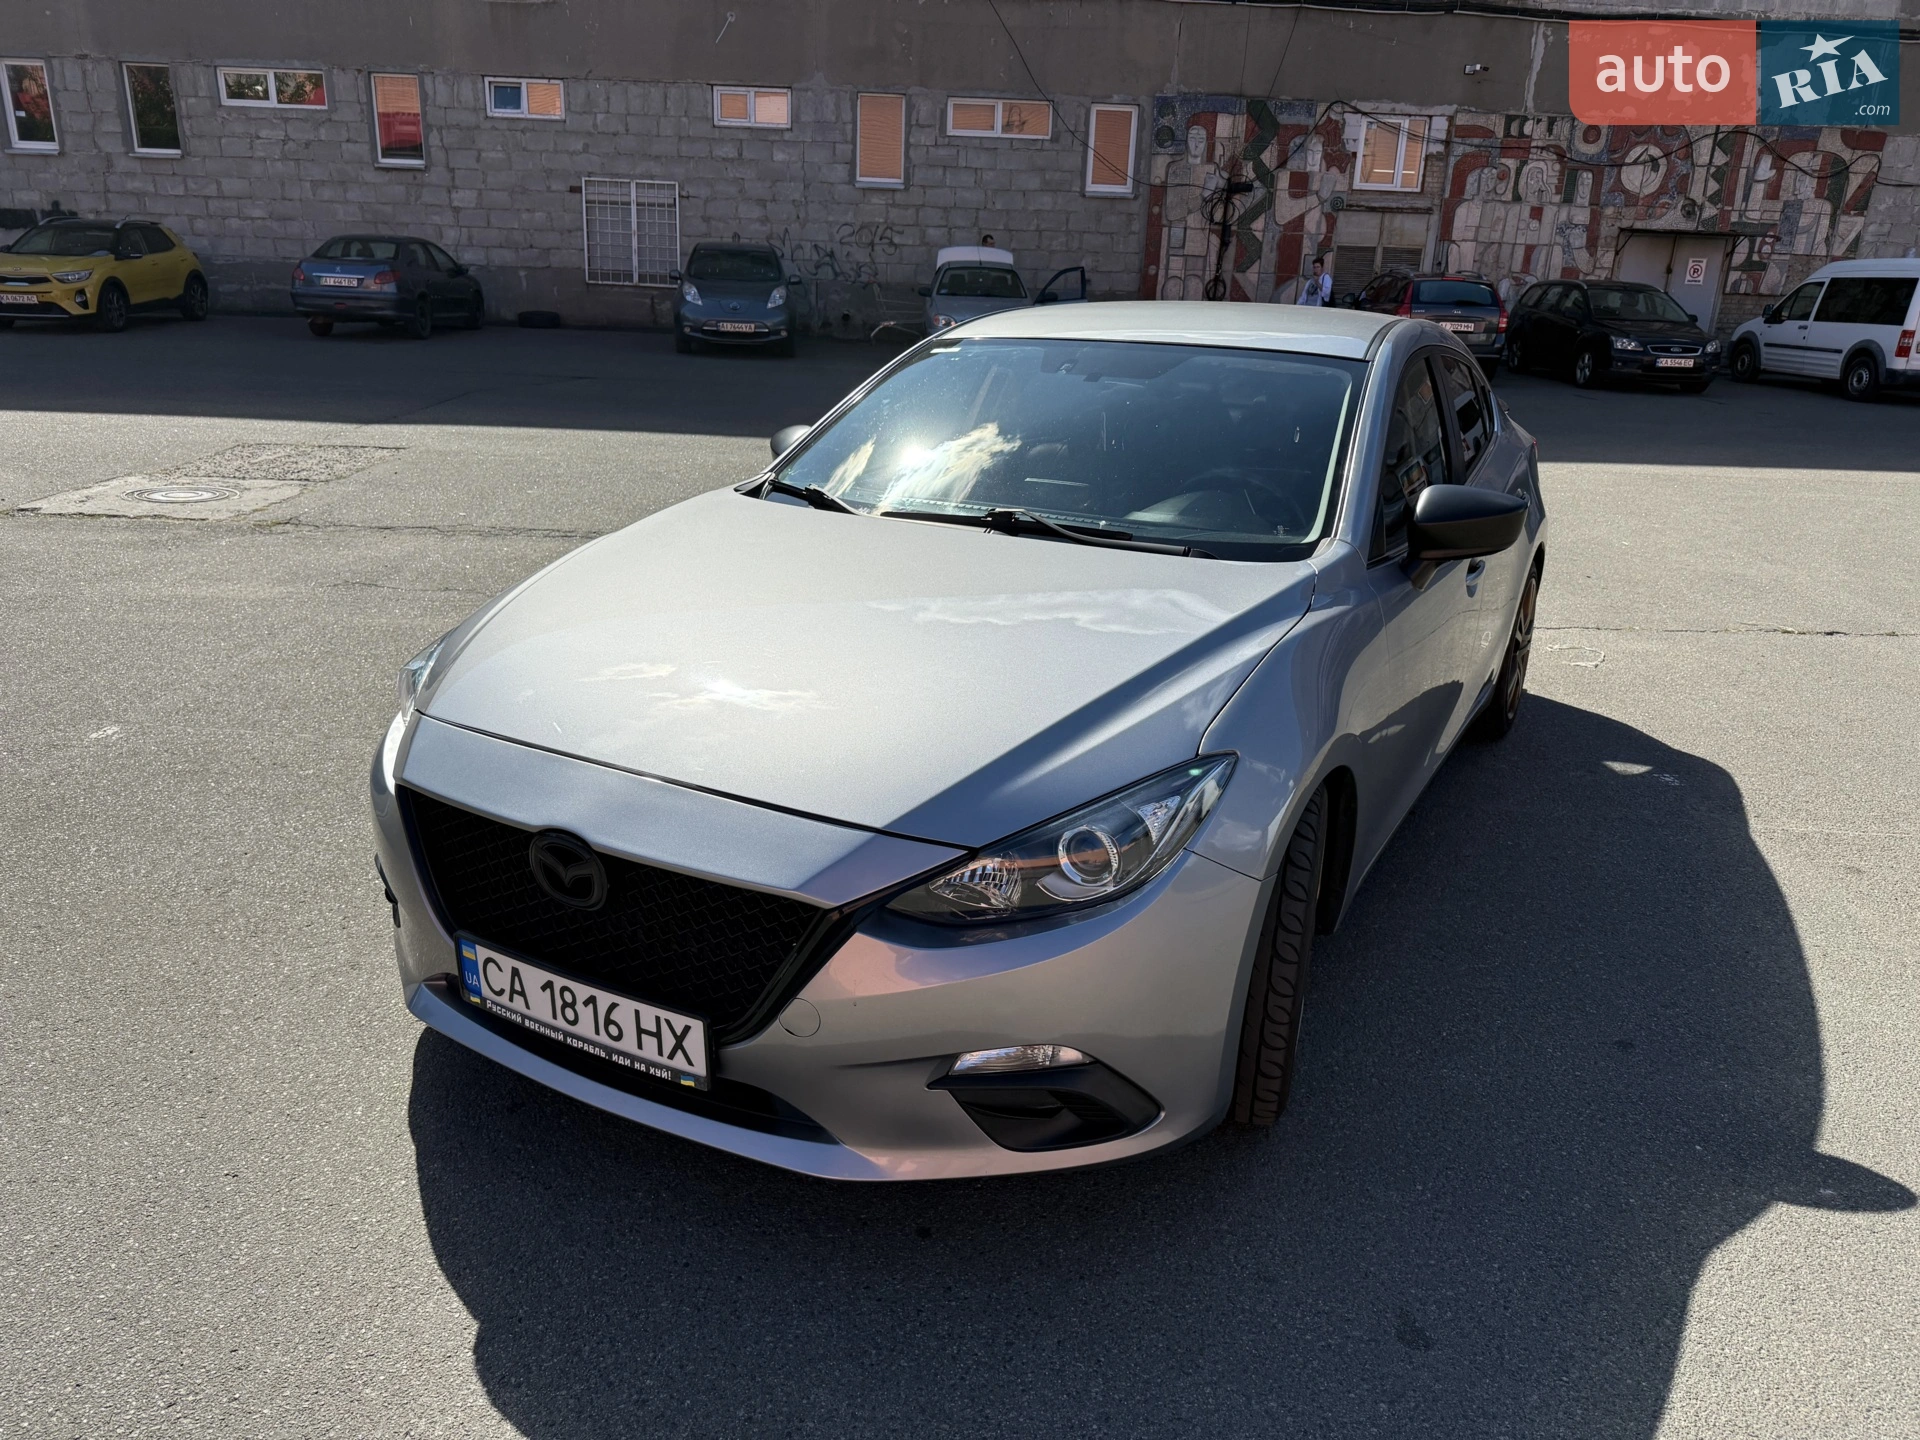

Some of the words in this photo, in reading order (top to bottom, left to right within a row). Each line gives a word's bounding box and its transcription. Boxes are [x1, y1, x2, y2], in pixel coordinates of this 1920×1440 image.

[464, 970, 481, 988] UA
[482, 956, 531, 1011] CA
[540, 979, 624, 1042] 1816
[634, 1009, 695, 1067] HX
